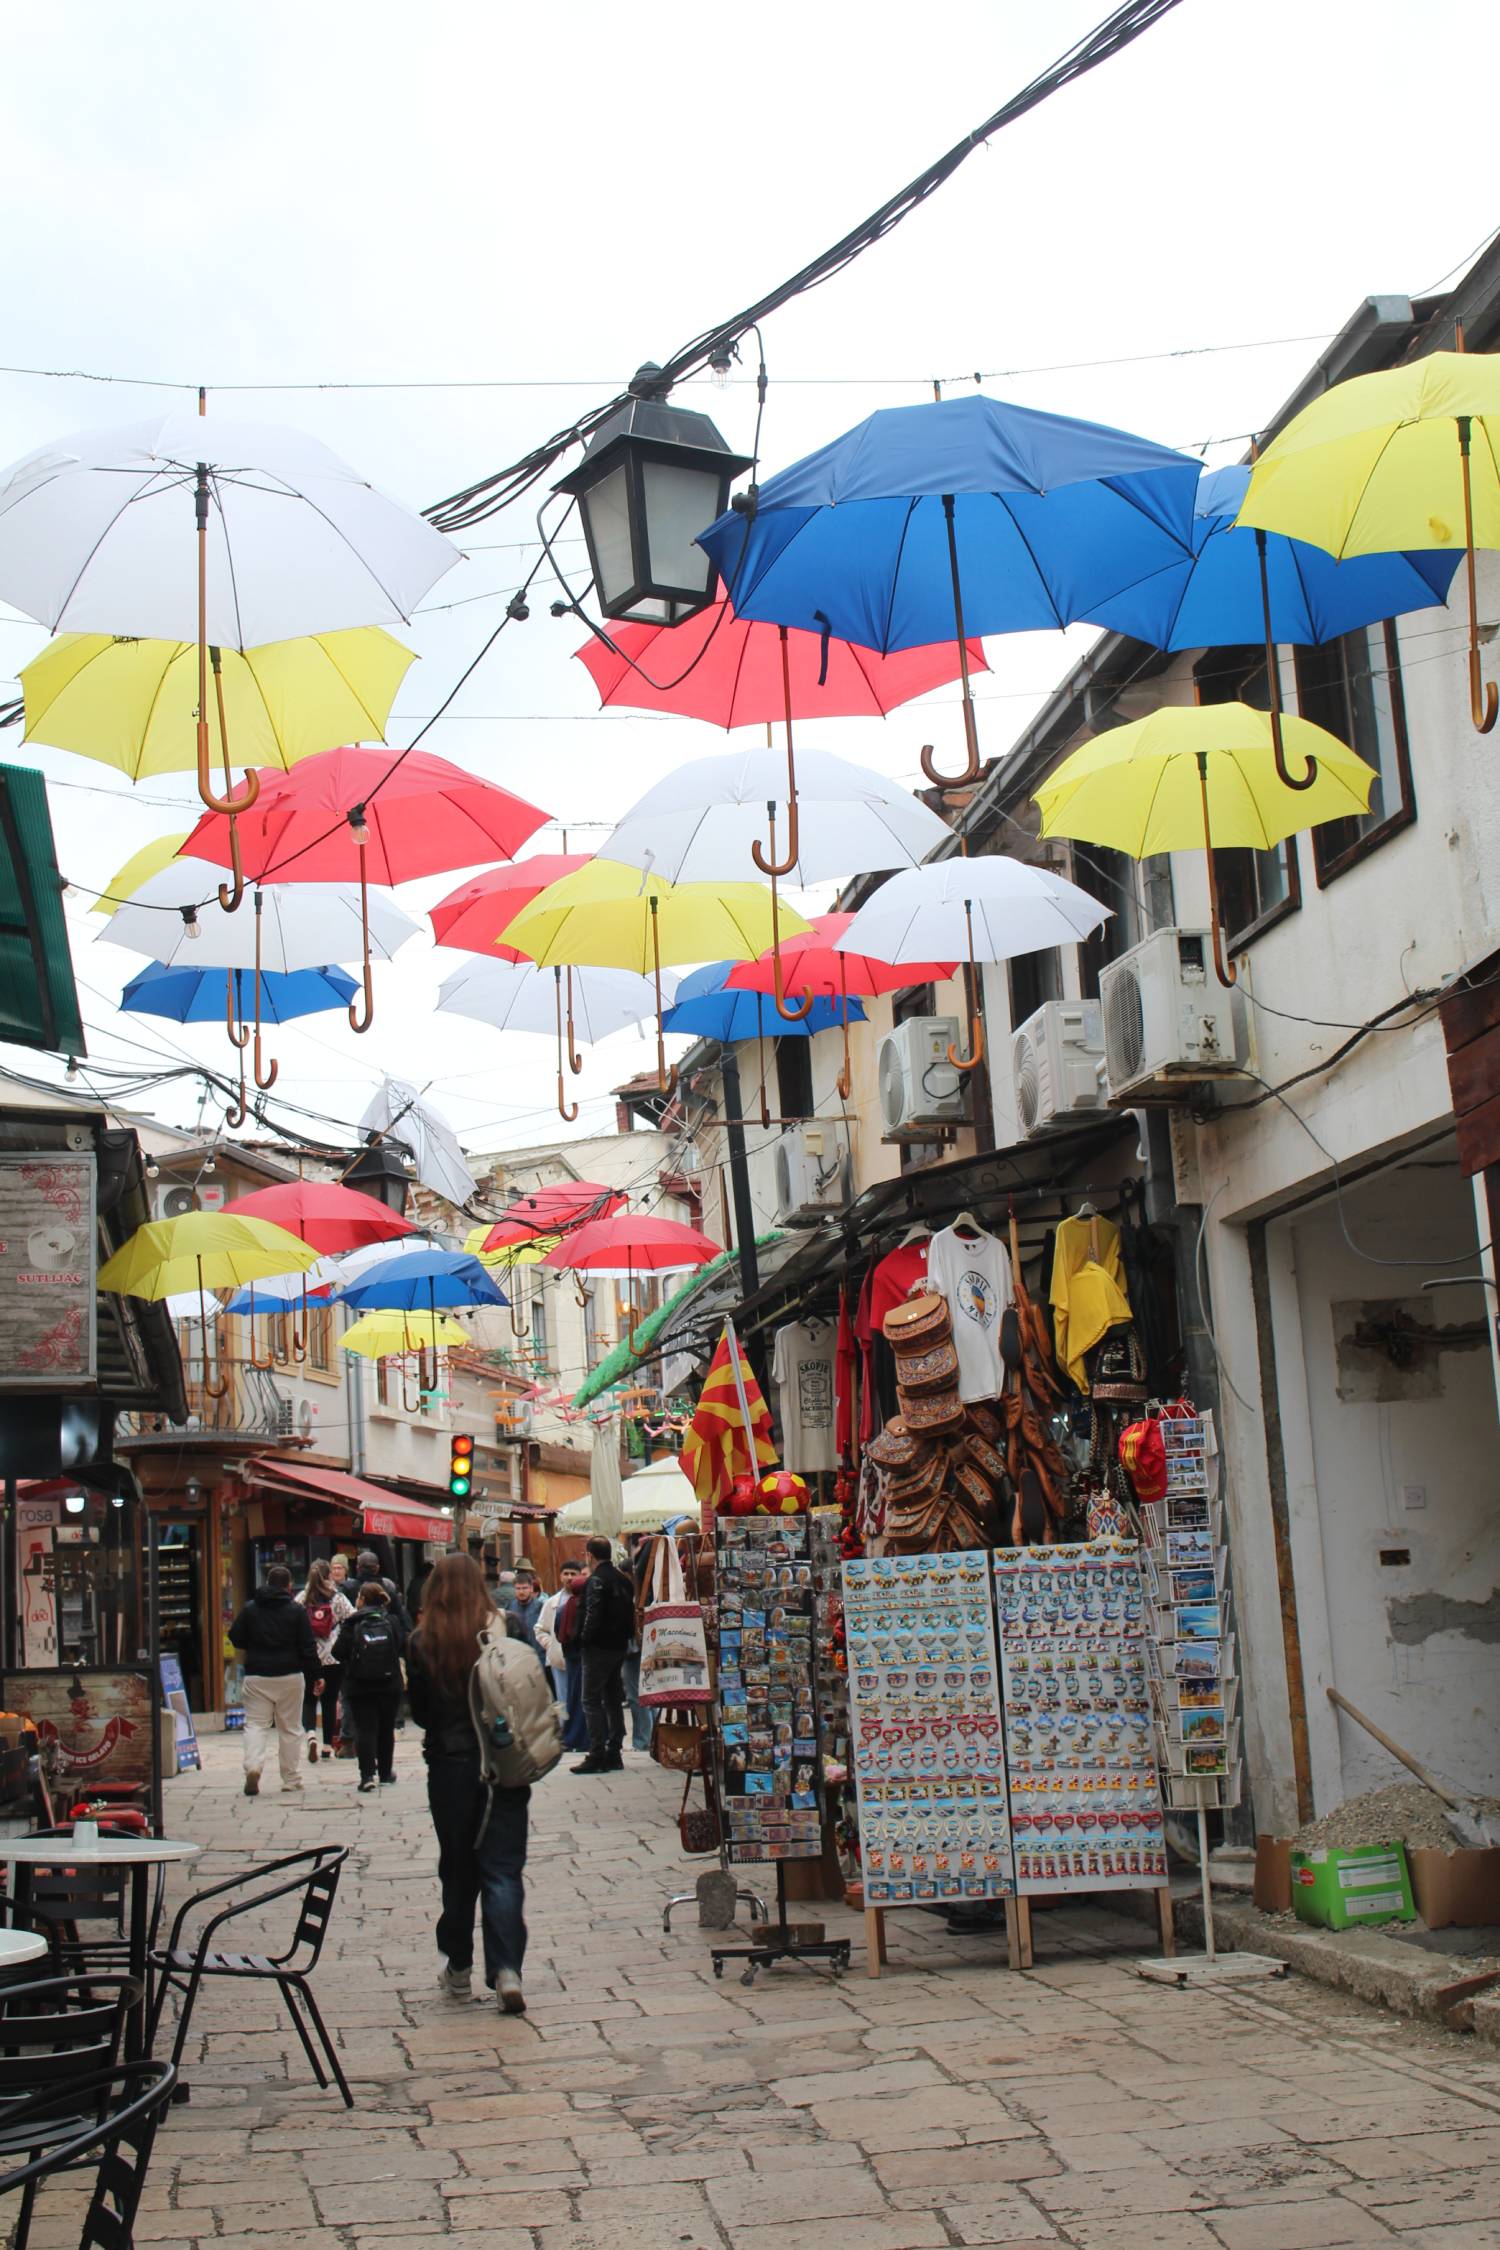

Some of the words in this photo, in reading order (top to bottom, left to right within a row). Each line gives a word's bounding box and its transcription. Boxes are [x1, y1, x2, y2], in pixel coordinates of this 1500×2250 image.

[800, 1361, 828, 1375] SKOPJE
[20, 1510, 54, 1522] rosa
[658, 1628, 697, 1637] Macedonia
[88, 1740, 112, 1762] GELATO
